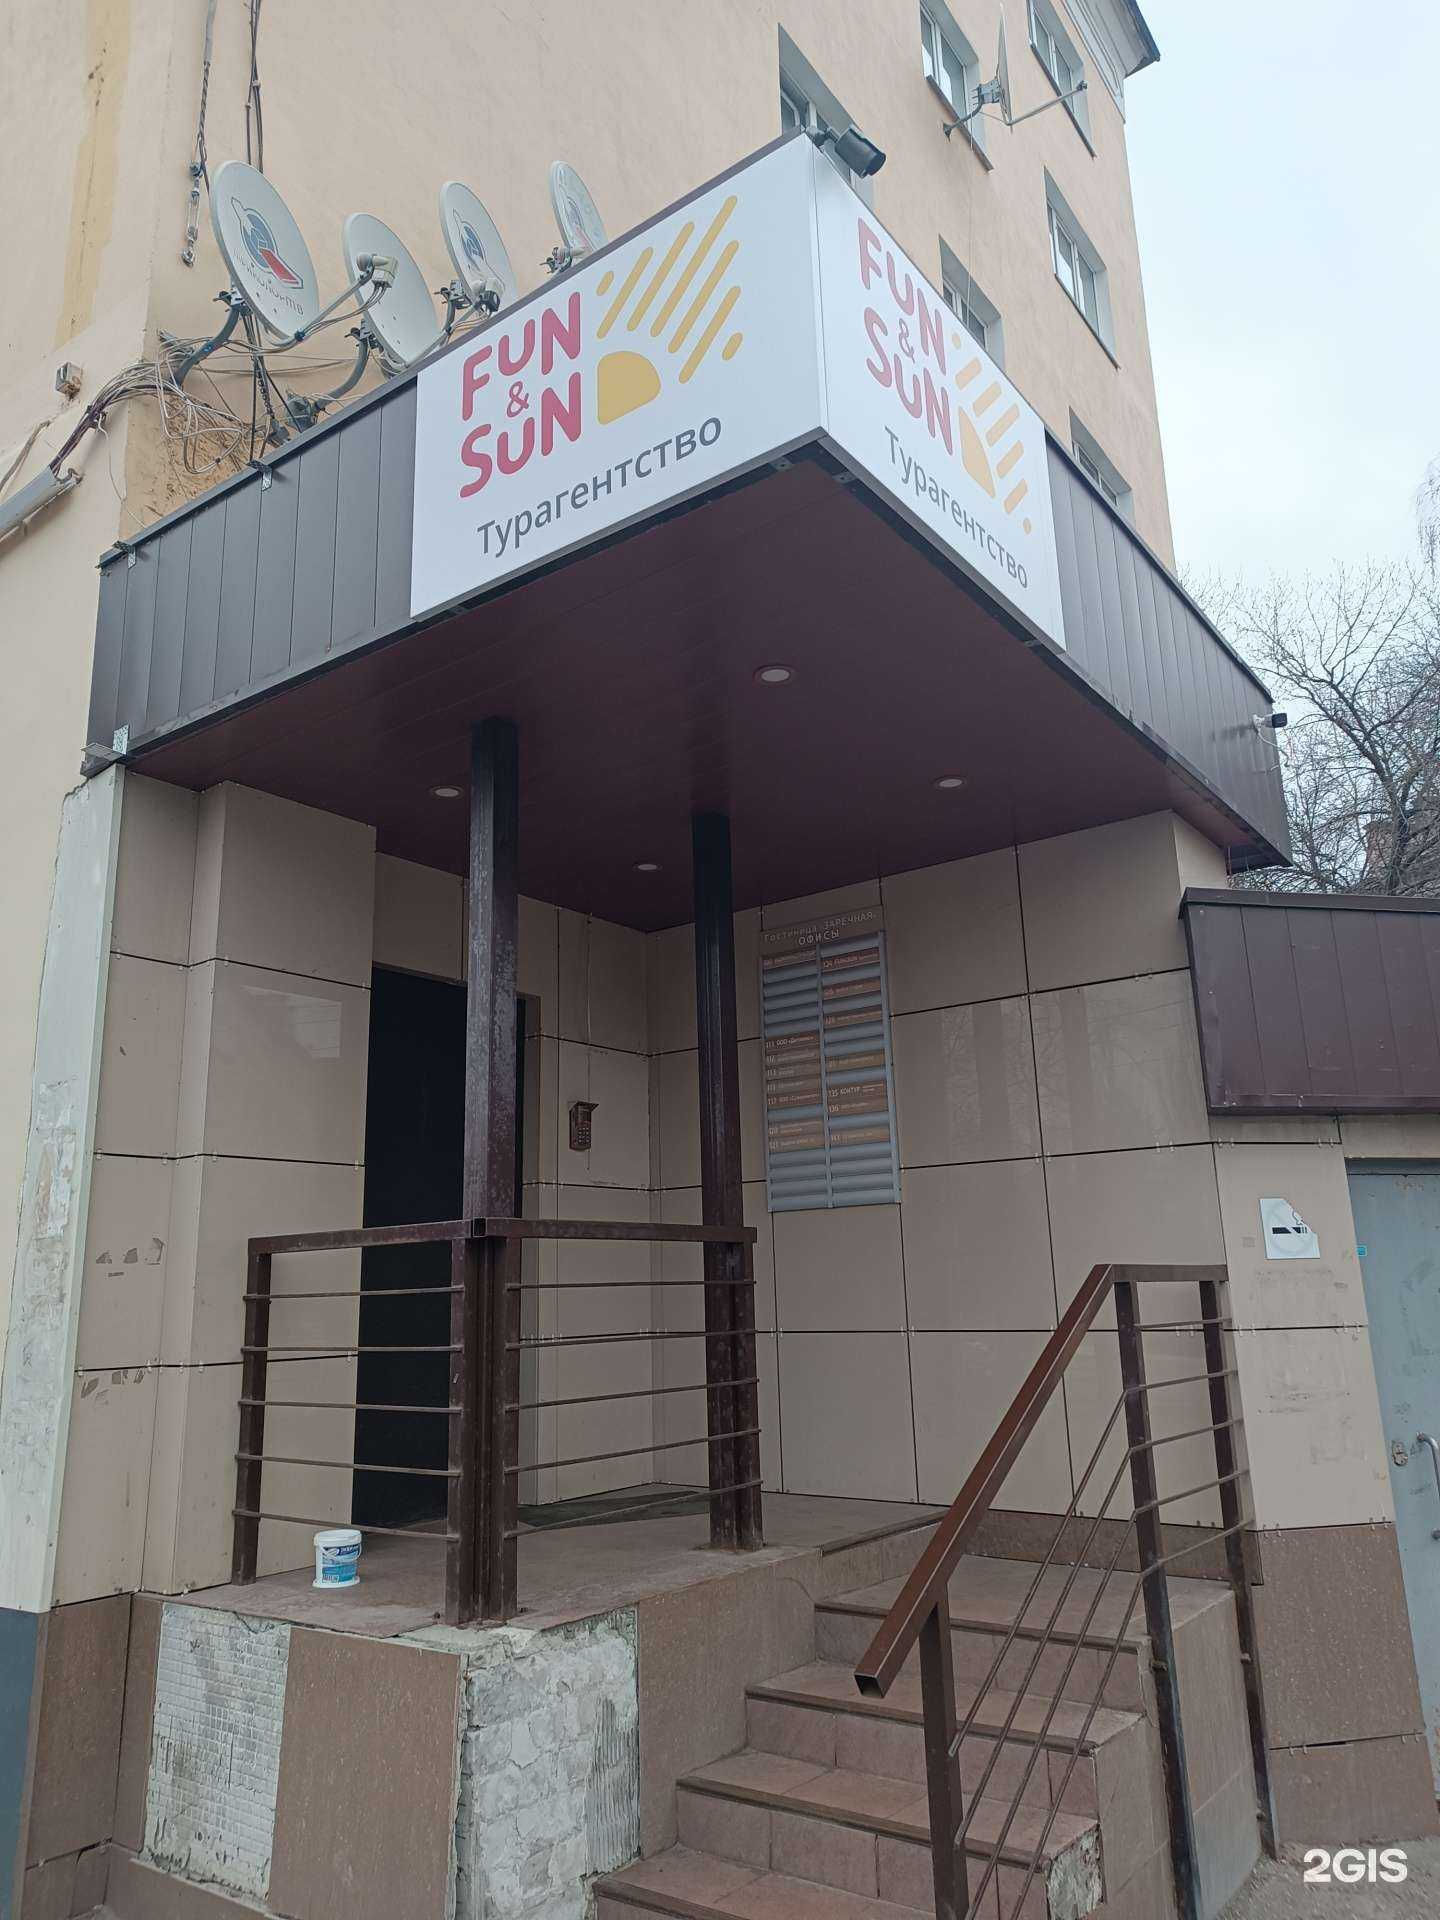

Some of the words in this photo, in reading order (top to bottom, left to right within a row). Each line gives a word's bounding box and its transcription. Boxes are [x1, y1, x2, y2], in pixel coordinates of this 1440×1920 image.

[462, 291, 581, 421] FUN
[857, 217, 947, 376] FUN
[898, 318, 916, 364] &
[459, 371, 582, 498] SUN
[506, 381, 530, 418] &
[864, 306, 953, 456] SUN
[476, 416, 722, 559] Турагентство
[884, 424, 1029, 590] Турагентство
[798, 929, 840, 945] ОФИСЫ
